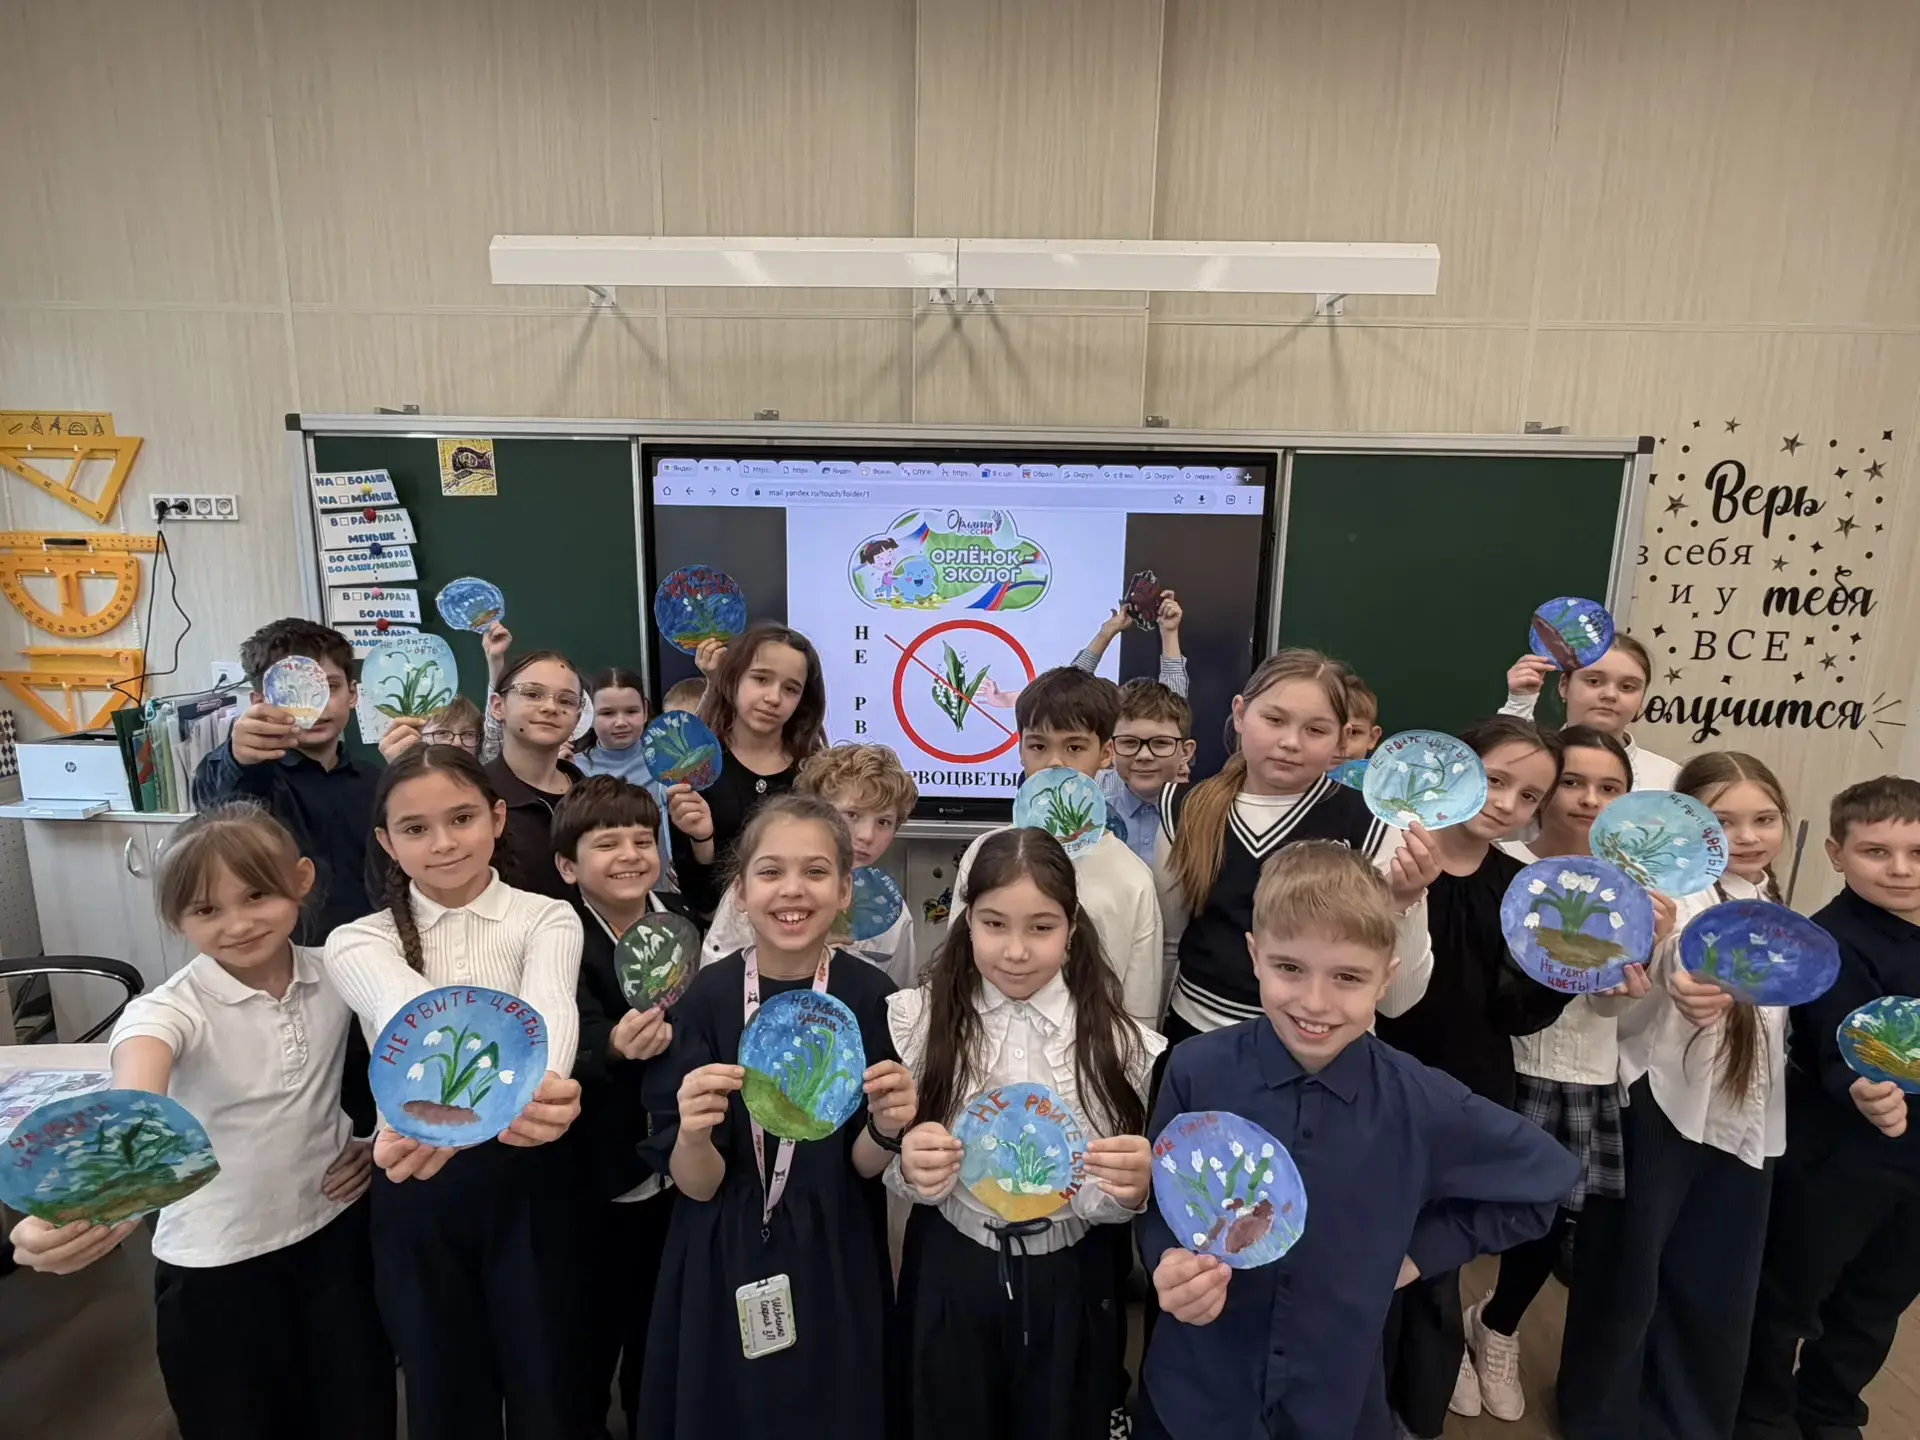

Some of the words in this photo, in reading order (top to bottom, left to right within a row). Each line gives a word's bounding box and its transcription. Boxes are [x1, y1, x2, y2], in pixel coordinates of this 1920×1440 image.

[315, 477, 334, 486] НА
[318, 495, 338, 504] НА
[351, 491, 394, 503] МЕНЬШЕ
[1704, 459, 1827, 539] Верь
[347, 532, 396, 544] МЕНЬШЕ
[328, 554, 345, 563] ВО
[394, 549, 409, 559] РАЗ
[930, 544, 1021, 566] ОРЛЁНОК
[1664, 536, 1754, 566] себя
[943, 567, 1022, 584] ЭКОЛОГ
[1669, 583, 1694, 605] и
[1713, 586, 1738, 616] у
[1762, 565, 1878, 618] тебя
[359, 609, 405, 619] БОЛЬШЕ
[354, 629, 369, 637] НА
[1690, 628, 1790, 662] ВСЕ
[1631, 693, 1867, 744] олучится
[65, 761, 77, 773] hp
[906, 770, 1018, 789] РВОЦВЕТЫ
[378, 1032, 409, 1066] НЕ
[404, 990, 478, 1030] РВИТЕ
[490, 995, 548, 1047] ЦВЕТЫ!
[967, 1089, 1011, 1123] НЕ
[1025, 1093, 1083, 1144] РВИТЕ
